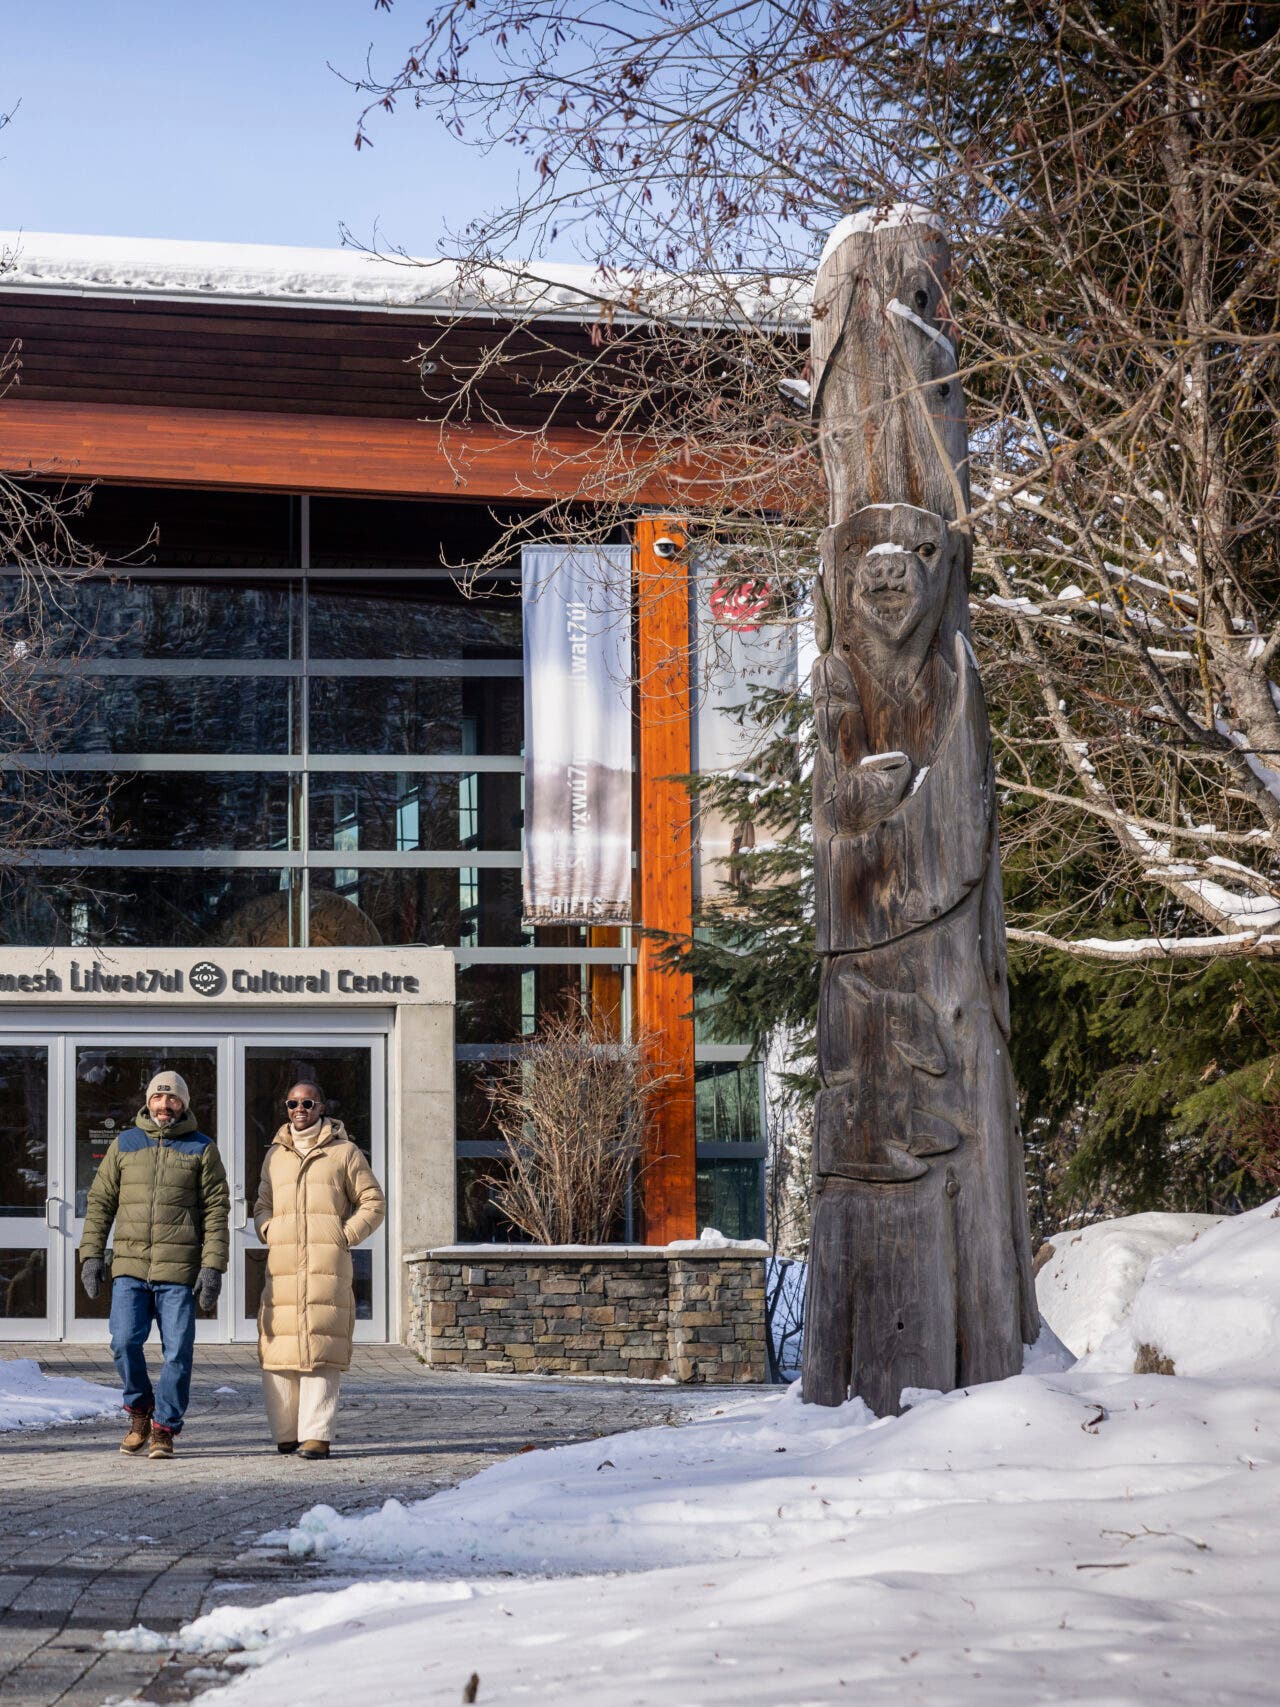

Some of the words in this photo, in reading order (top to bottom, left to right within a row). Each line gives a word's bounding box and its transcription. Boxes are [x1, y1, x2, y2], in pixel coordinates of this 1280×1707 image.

[551, 896, 603, 914] GIFTS
[232, 969, 330, 993] Cultural
[338, 969, 419, 993] Centre
